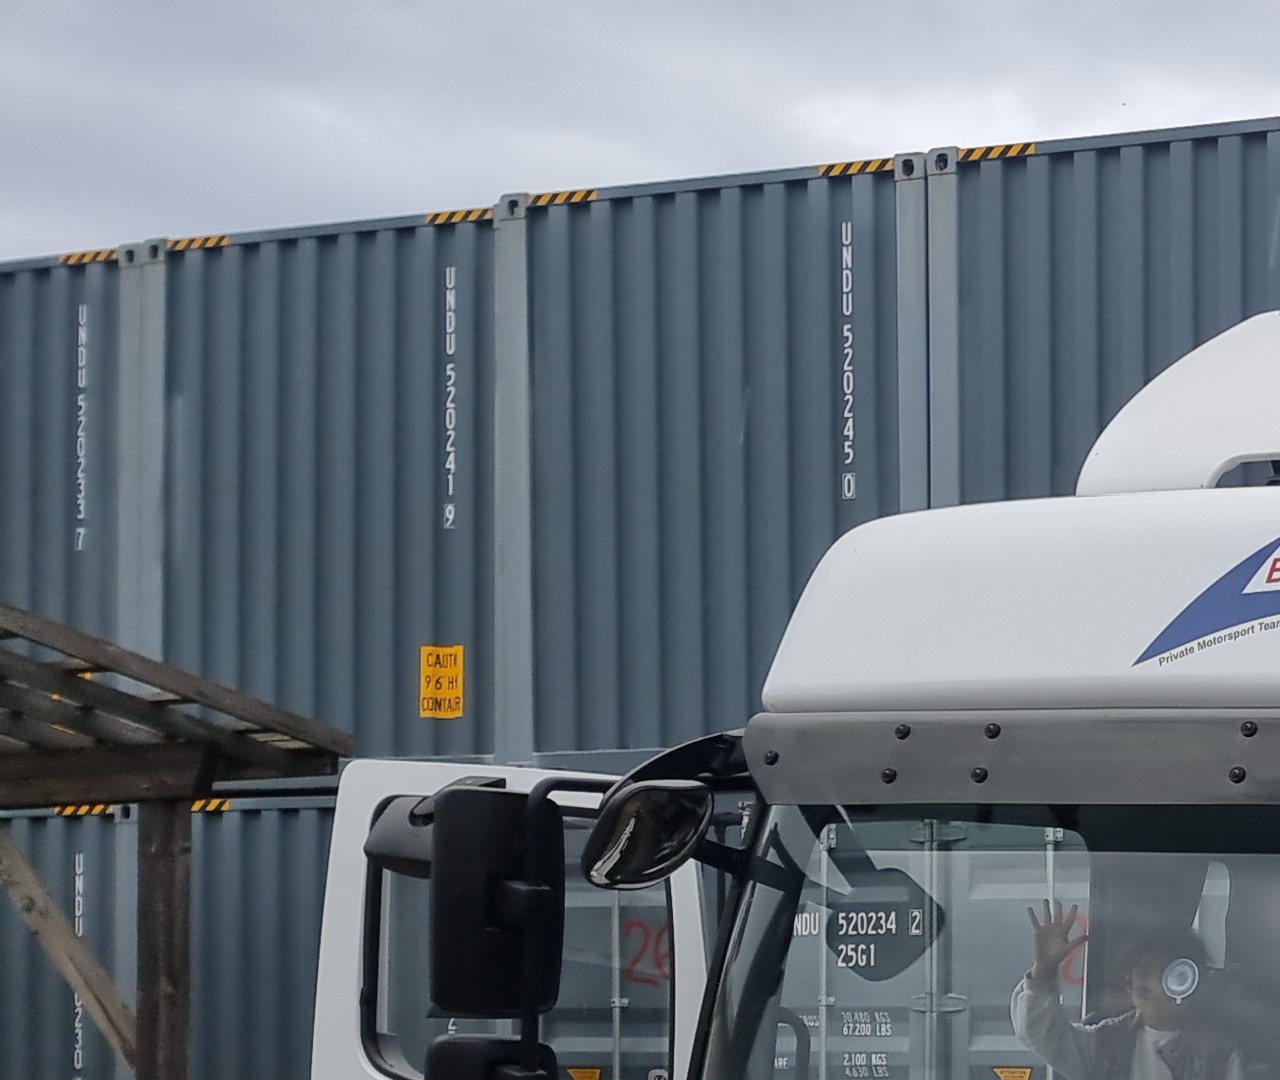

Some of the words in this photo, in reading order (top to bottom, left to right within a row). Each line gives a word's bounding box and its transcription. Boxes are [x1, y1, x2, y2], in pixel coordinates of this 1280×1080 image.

[445, 266, 456, 355] UNDU
[841, 222, 852, 315] UNDU
[78, 304, 87, 388] UNDU
[445, 363, 456, 495] 520241
[842, 324, 854, 464] 520245
[1158, 646, 1195, 666] Private
[1197, 625, 1255, 651] Motorsport
[75, 853, 83, 938] UNDU
[793, 911, 819, 936] NDU
[838, 911, 896, 936] 520234
[910, 910, 921, 934] 2
[837, 943, 876, 967] 25G1
[774, 1057, 789, 1069] ARE
[843, 1053, 866, 1065] 2.100
[871, 1053, 887, 1065] KGS
[876, 1024, 892, 1036] LBS
